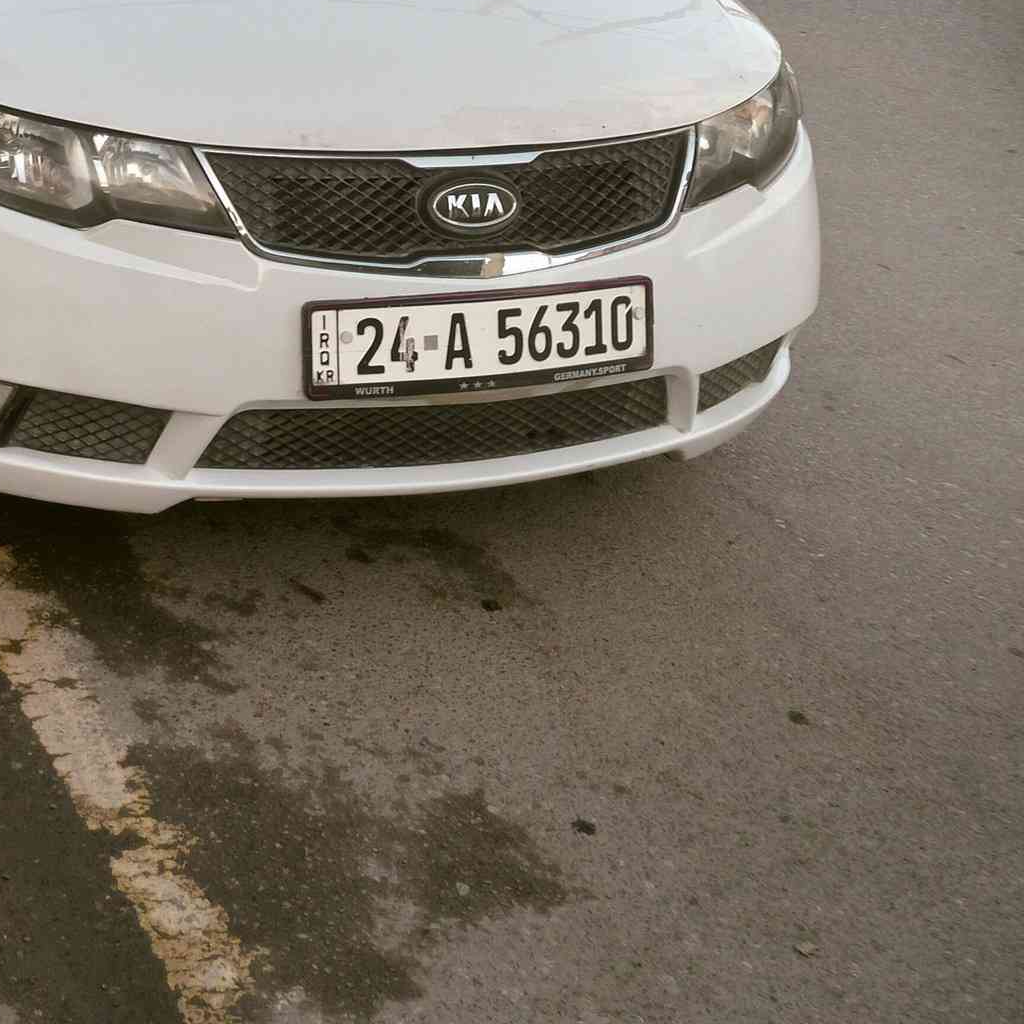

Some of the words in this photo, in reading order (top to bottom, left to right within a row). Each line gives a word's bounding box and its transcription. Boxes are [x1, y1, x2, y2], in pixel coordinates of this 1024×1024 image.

[447, 192, 505, 218] KIA
[356, 316, 418, 375] 24
[445, 312, 473, 370] A
[497, 296, 633, 365] 56310
[316, 370, 335, 384] KR
[355, 385, 394, 396] WURTH
